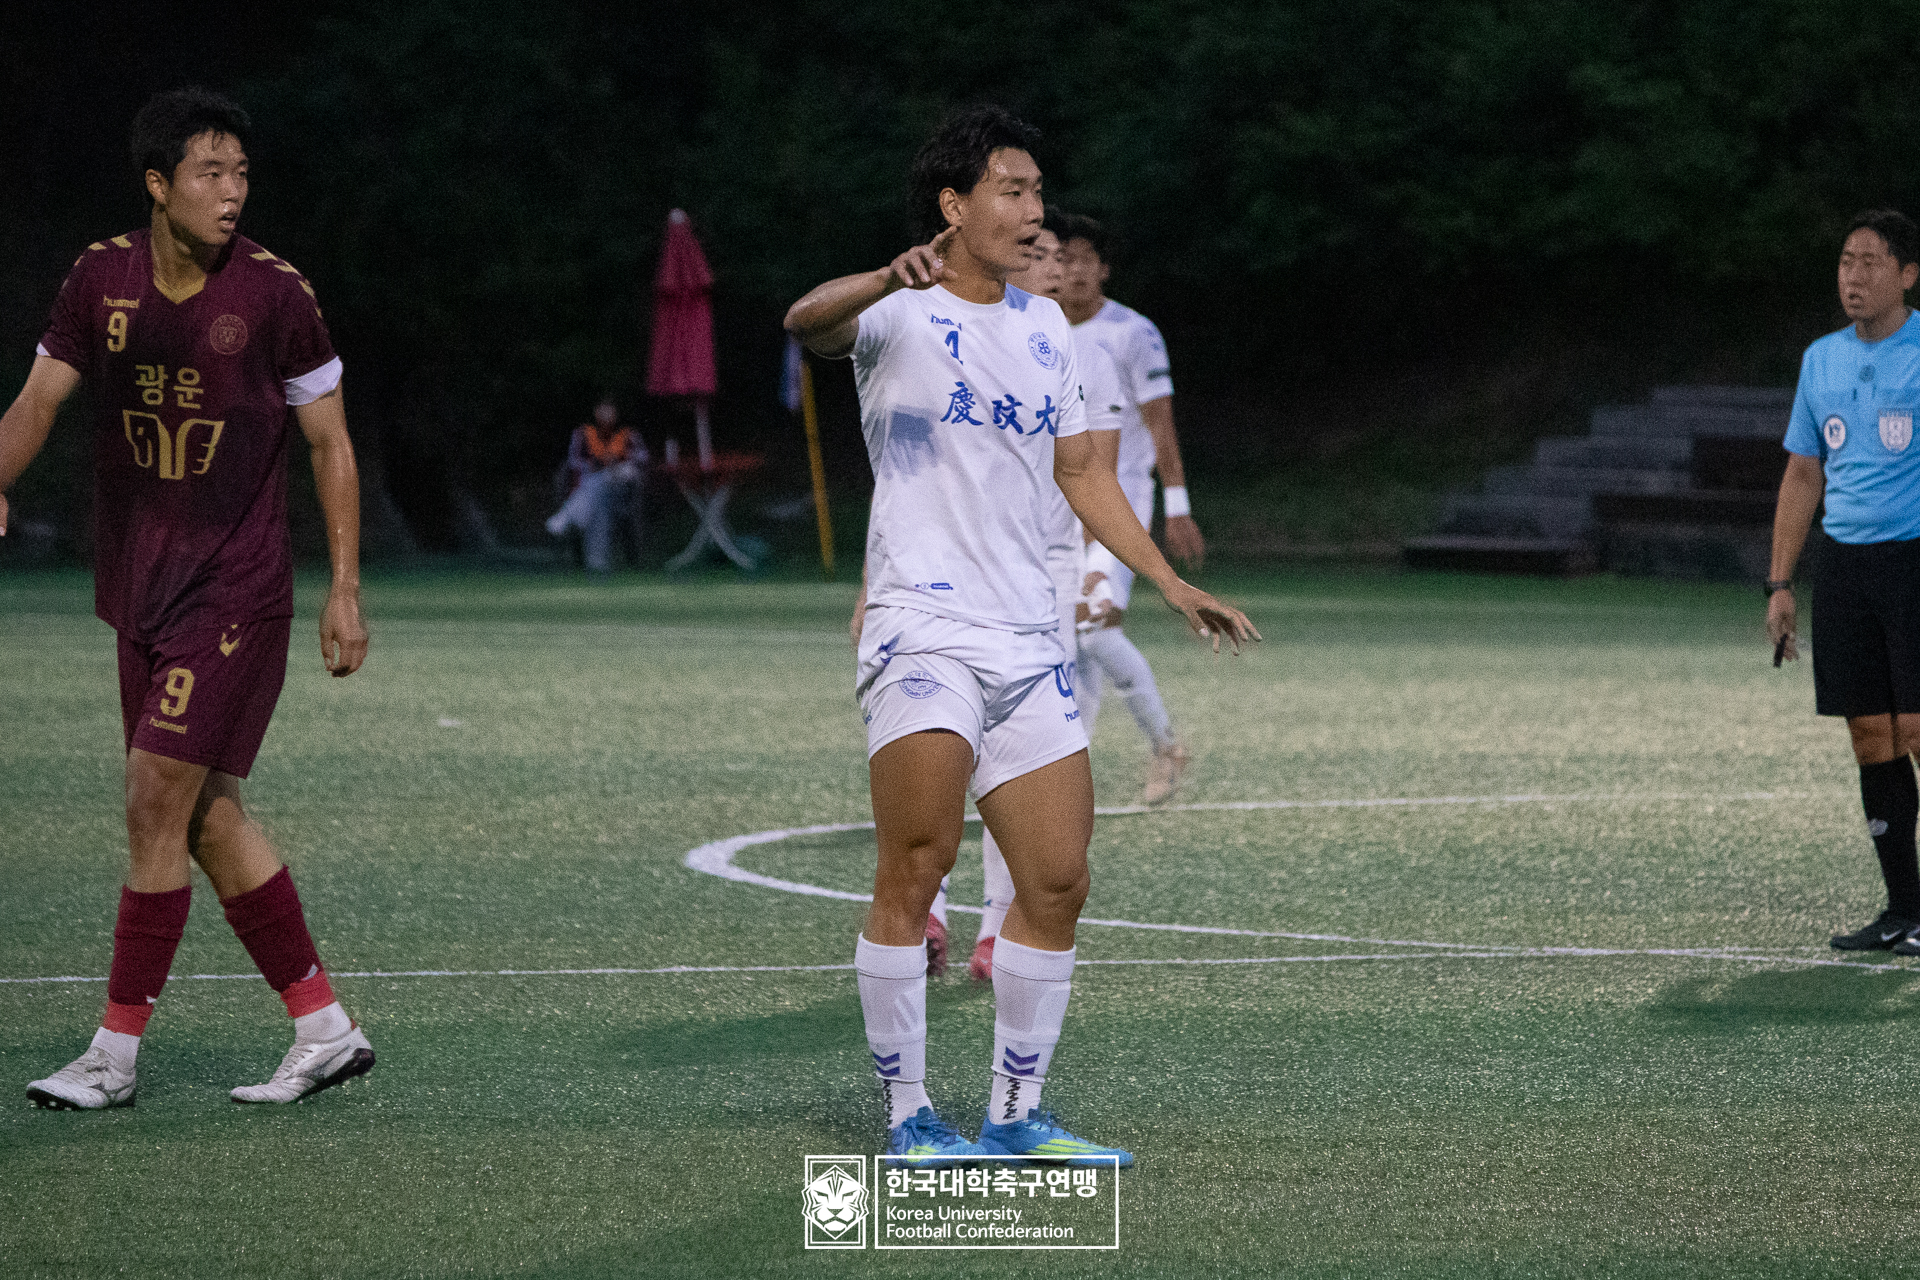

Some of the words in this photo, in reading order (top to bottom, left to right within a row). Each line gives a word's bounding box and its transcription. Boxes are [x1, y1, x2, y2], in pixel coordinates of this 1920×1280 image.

[107, 311, 128, 352] 9
[135, 364, 204, 410] 광운
[160, 667, 195, 717] 9
